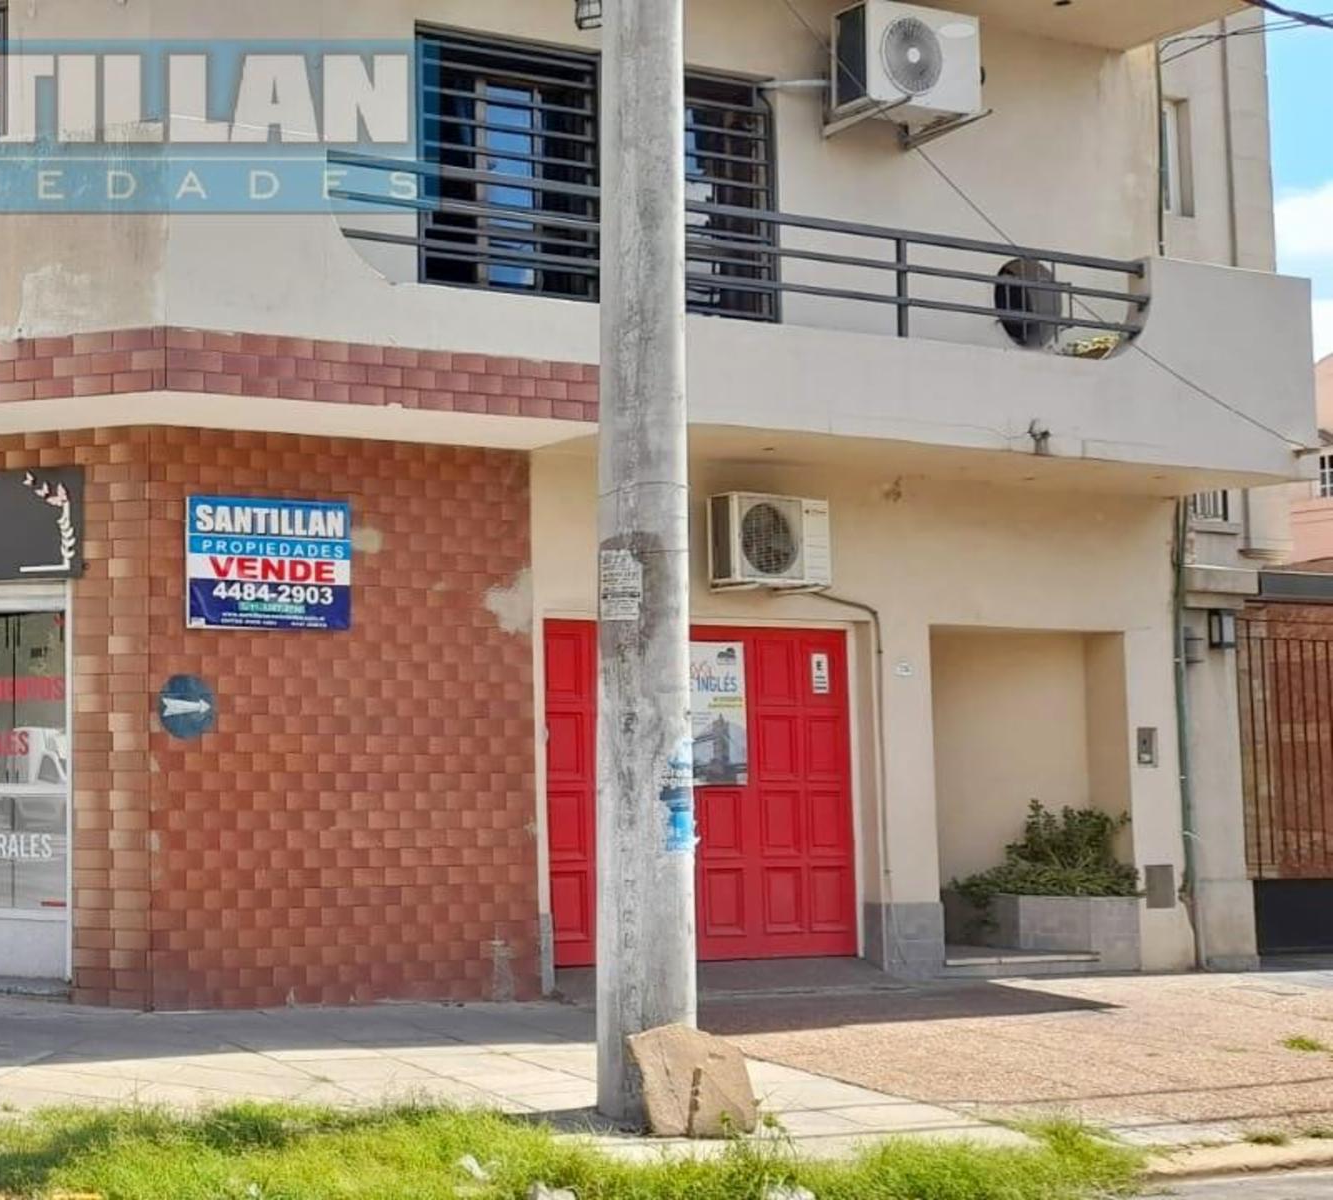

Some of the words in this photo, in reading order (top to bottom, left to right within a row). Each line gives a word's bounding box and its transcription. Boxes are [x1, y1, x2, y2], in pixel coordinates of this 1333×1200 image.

[195, 504, 345, 538] SANTILLAN
[201, 539, 345, 559] PROPIEDADES
[209, 556, 336, 584] VENDE
[212, 581, 334, 606] 4484-2903
[696, 672, 739, 693] INGLÉS
